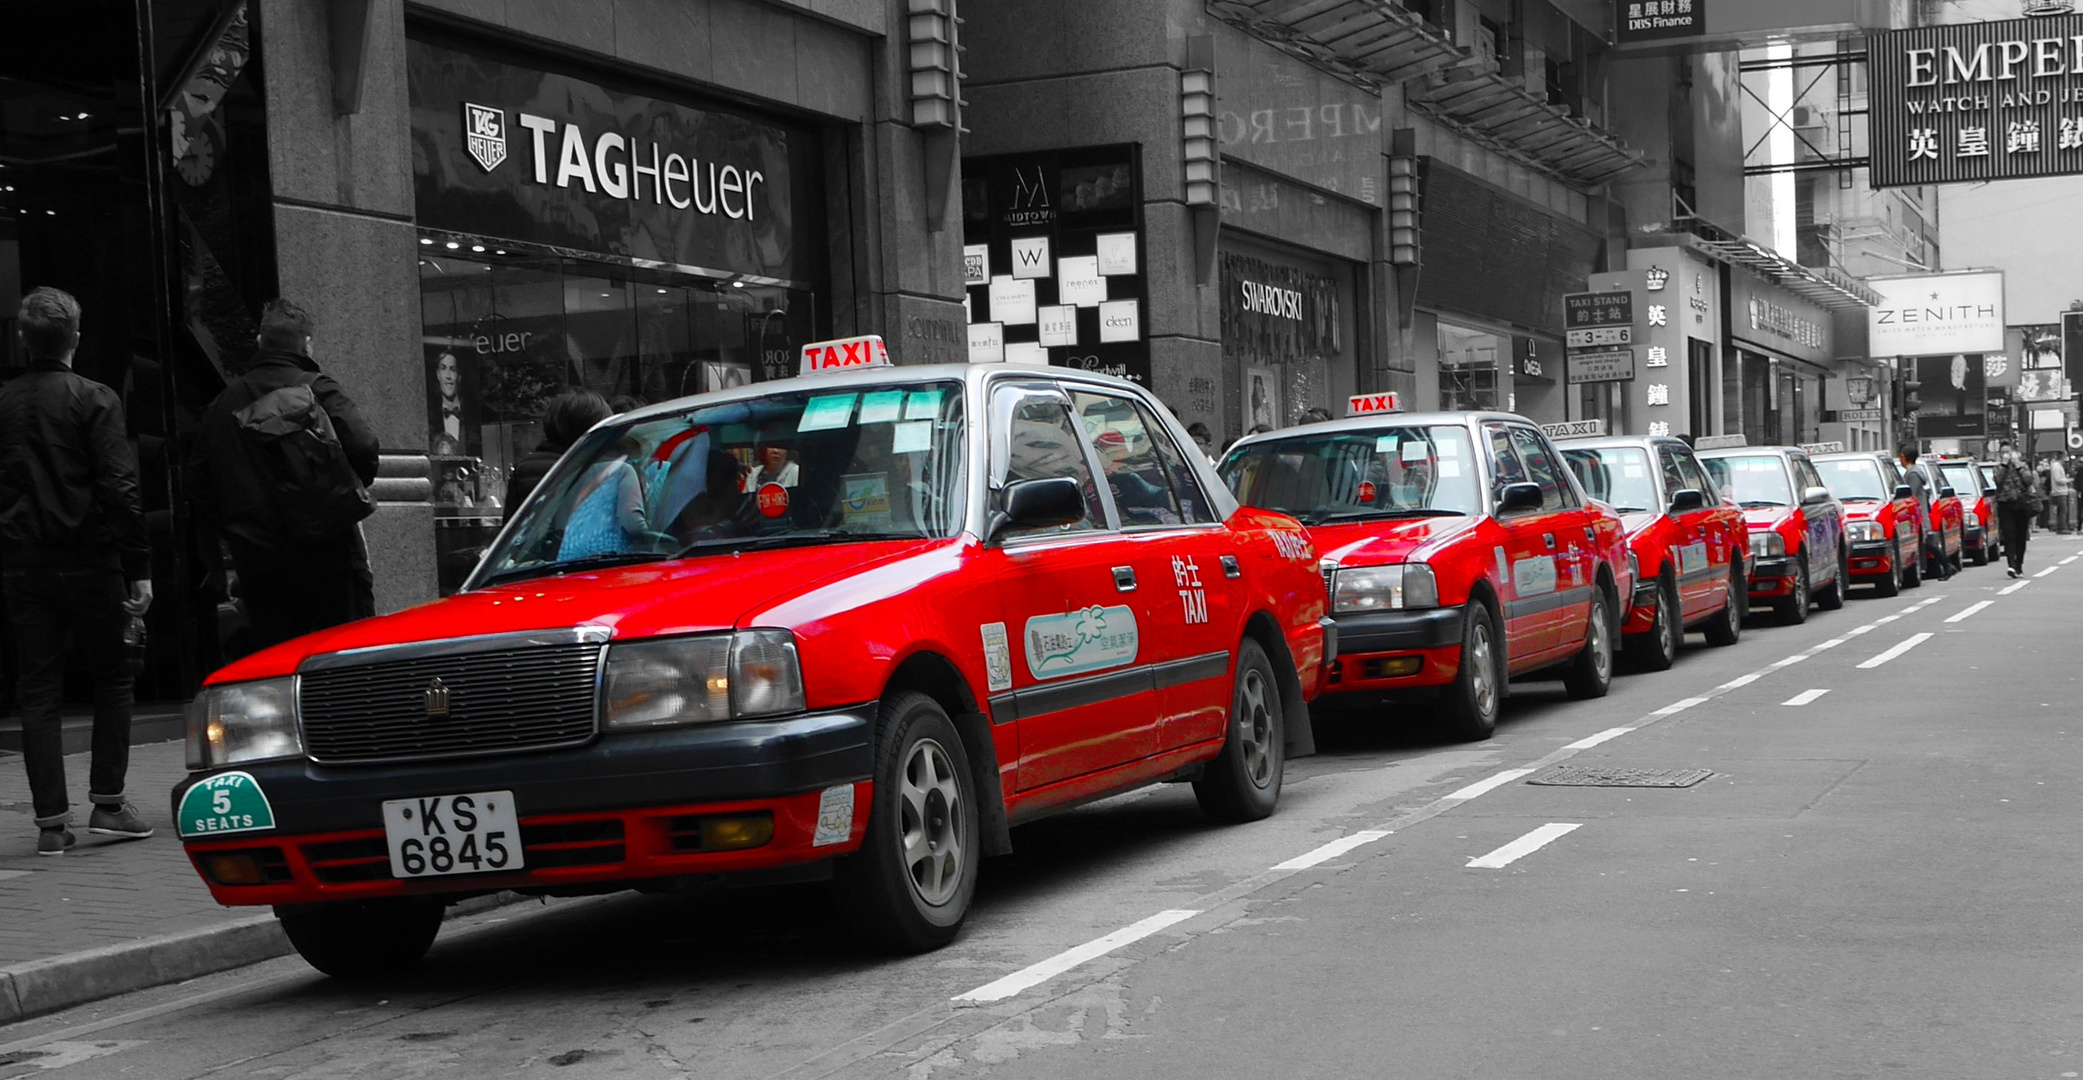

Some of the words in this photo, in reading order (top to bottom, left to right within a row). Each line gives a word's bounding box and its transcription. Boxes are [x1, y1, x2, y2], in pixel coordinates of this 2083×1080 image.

[1628, 0, 1692, 18] 星展財務
[1629, 18, 1652, 30] DBS
[1653, 16, 1693, 28] Finance
[1907, 95, 1990, 115] WATCH
[2001, 91, 2051, 108] AND
[472, 109, 499, 137] TAG
[470, 137, 504, 166] HEUER
[1018, 248, 1043, 267] W
[1242, 280, 1302, 321] SWAROVSKI
[1569, 298, 1591, 308] TAXI
[1593, 296, 1628, 306] STAND
[1577, 307, 1622, 324] 的士站
[1877, 304, 1994, 324] ZENITH
[1585, 332, 1594, 344] 3
[1620, 329, 1629, 341] 6
[805, 340, 871, 370] TAXI
[1350, 395, 1395, 413] TAXI
[1843, 411, 1881, 420] ROLEX
[1542, 421, 1597, 437] TAXI
[1172, 554, 1203, 588] 的士
[1179, 589, 1208, 625] TAXI
[204, 775, 246, 791] TAXI
[212, 789, 232, 815] 5
[195, 814, 254, 832] SEATS
[419, 796, 478, 836] KS
[401, 831, 509, 875] 6845
